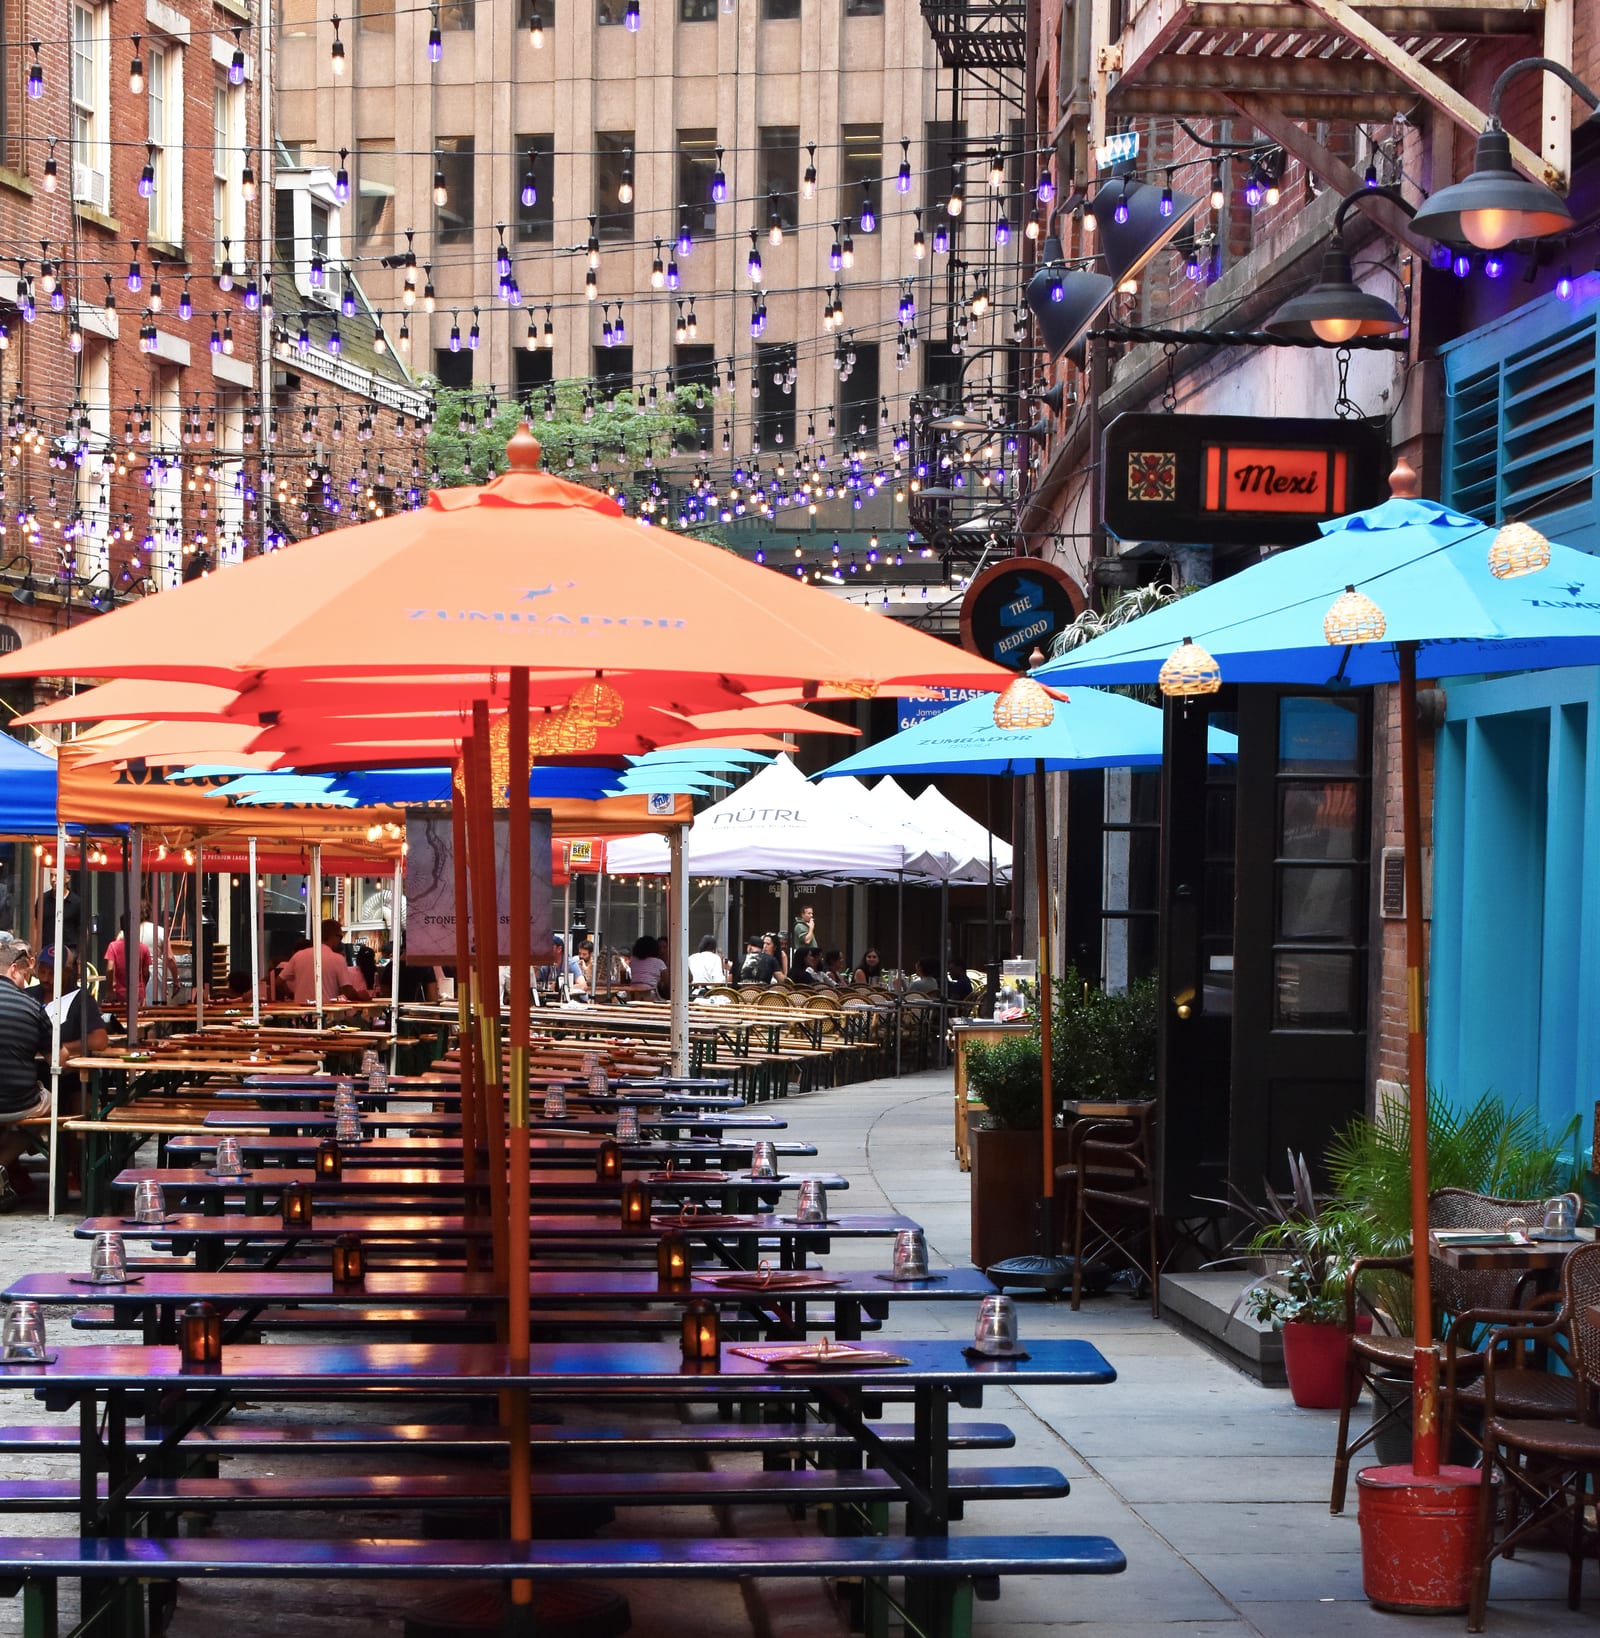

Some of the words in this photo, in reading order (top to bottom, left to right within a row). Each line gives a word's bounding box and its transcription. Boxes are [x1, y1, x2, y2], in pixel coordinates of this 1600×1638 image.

[1234, 464, 1318, 496] Mexi
[1008, 595, 1032, 616] THE
[999, 619, 1048, 653] BEDFORD
[941, 688, 985, 702] LEASE
[918, 735, 1032, 746] ZUMBADOR
[424, 916, 456, 925] STONE
